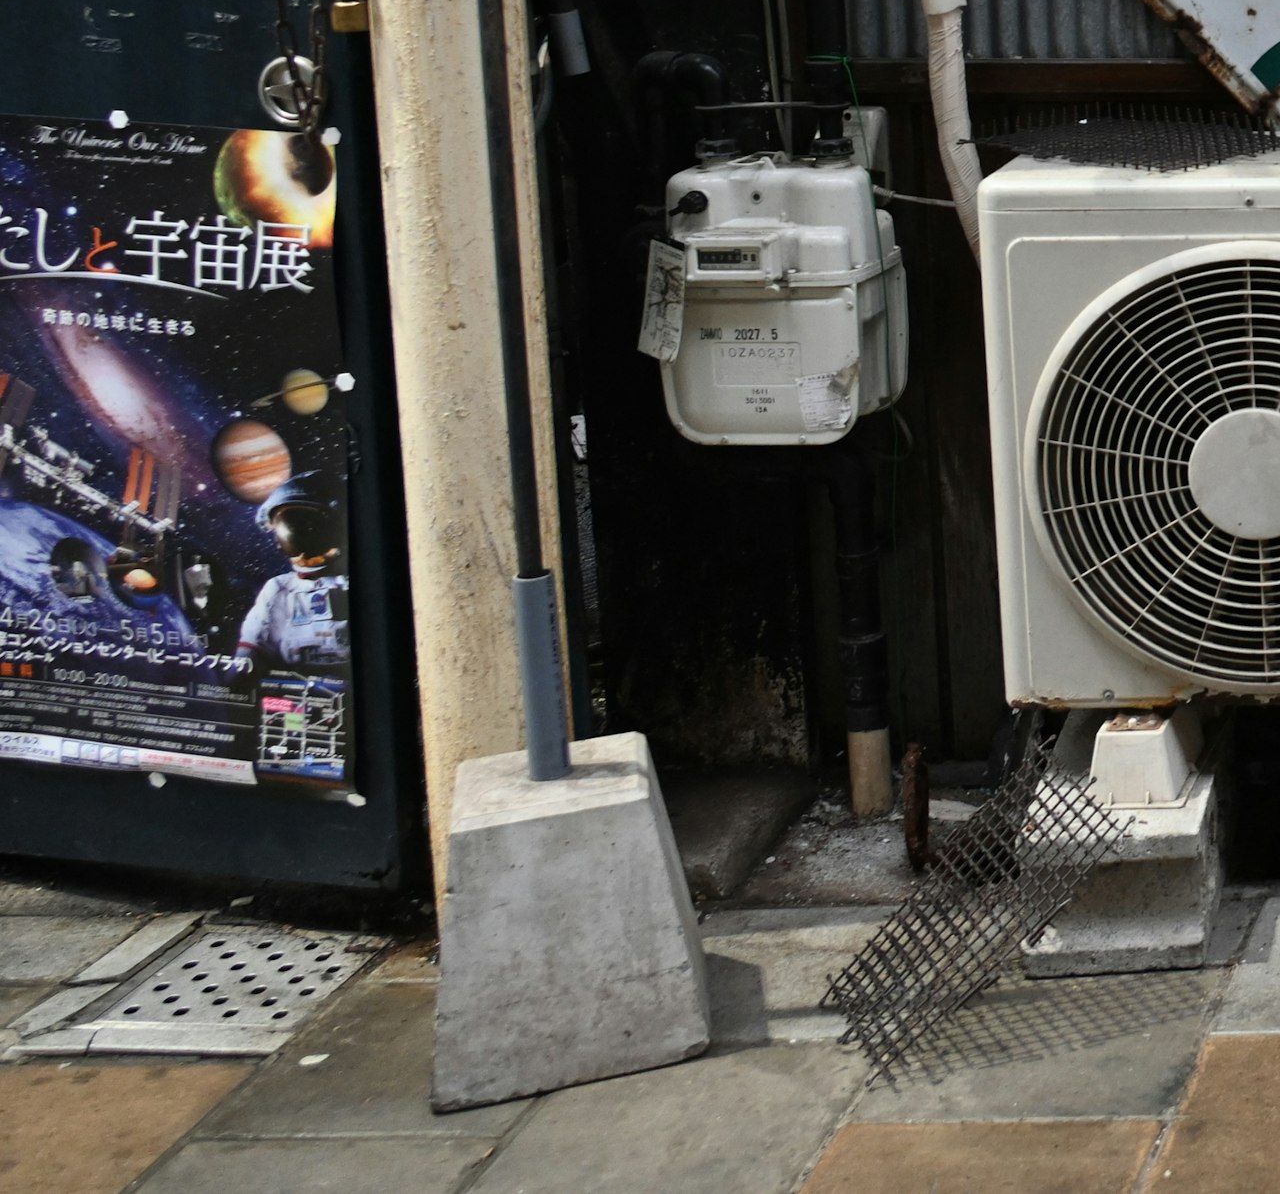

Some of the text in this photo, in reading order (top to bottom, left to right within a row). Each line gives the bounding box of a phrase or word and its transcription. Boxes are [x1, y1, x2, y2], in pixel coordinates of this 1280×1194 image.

[43, 308, 196, 336] 奇跡の地球に生きる
